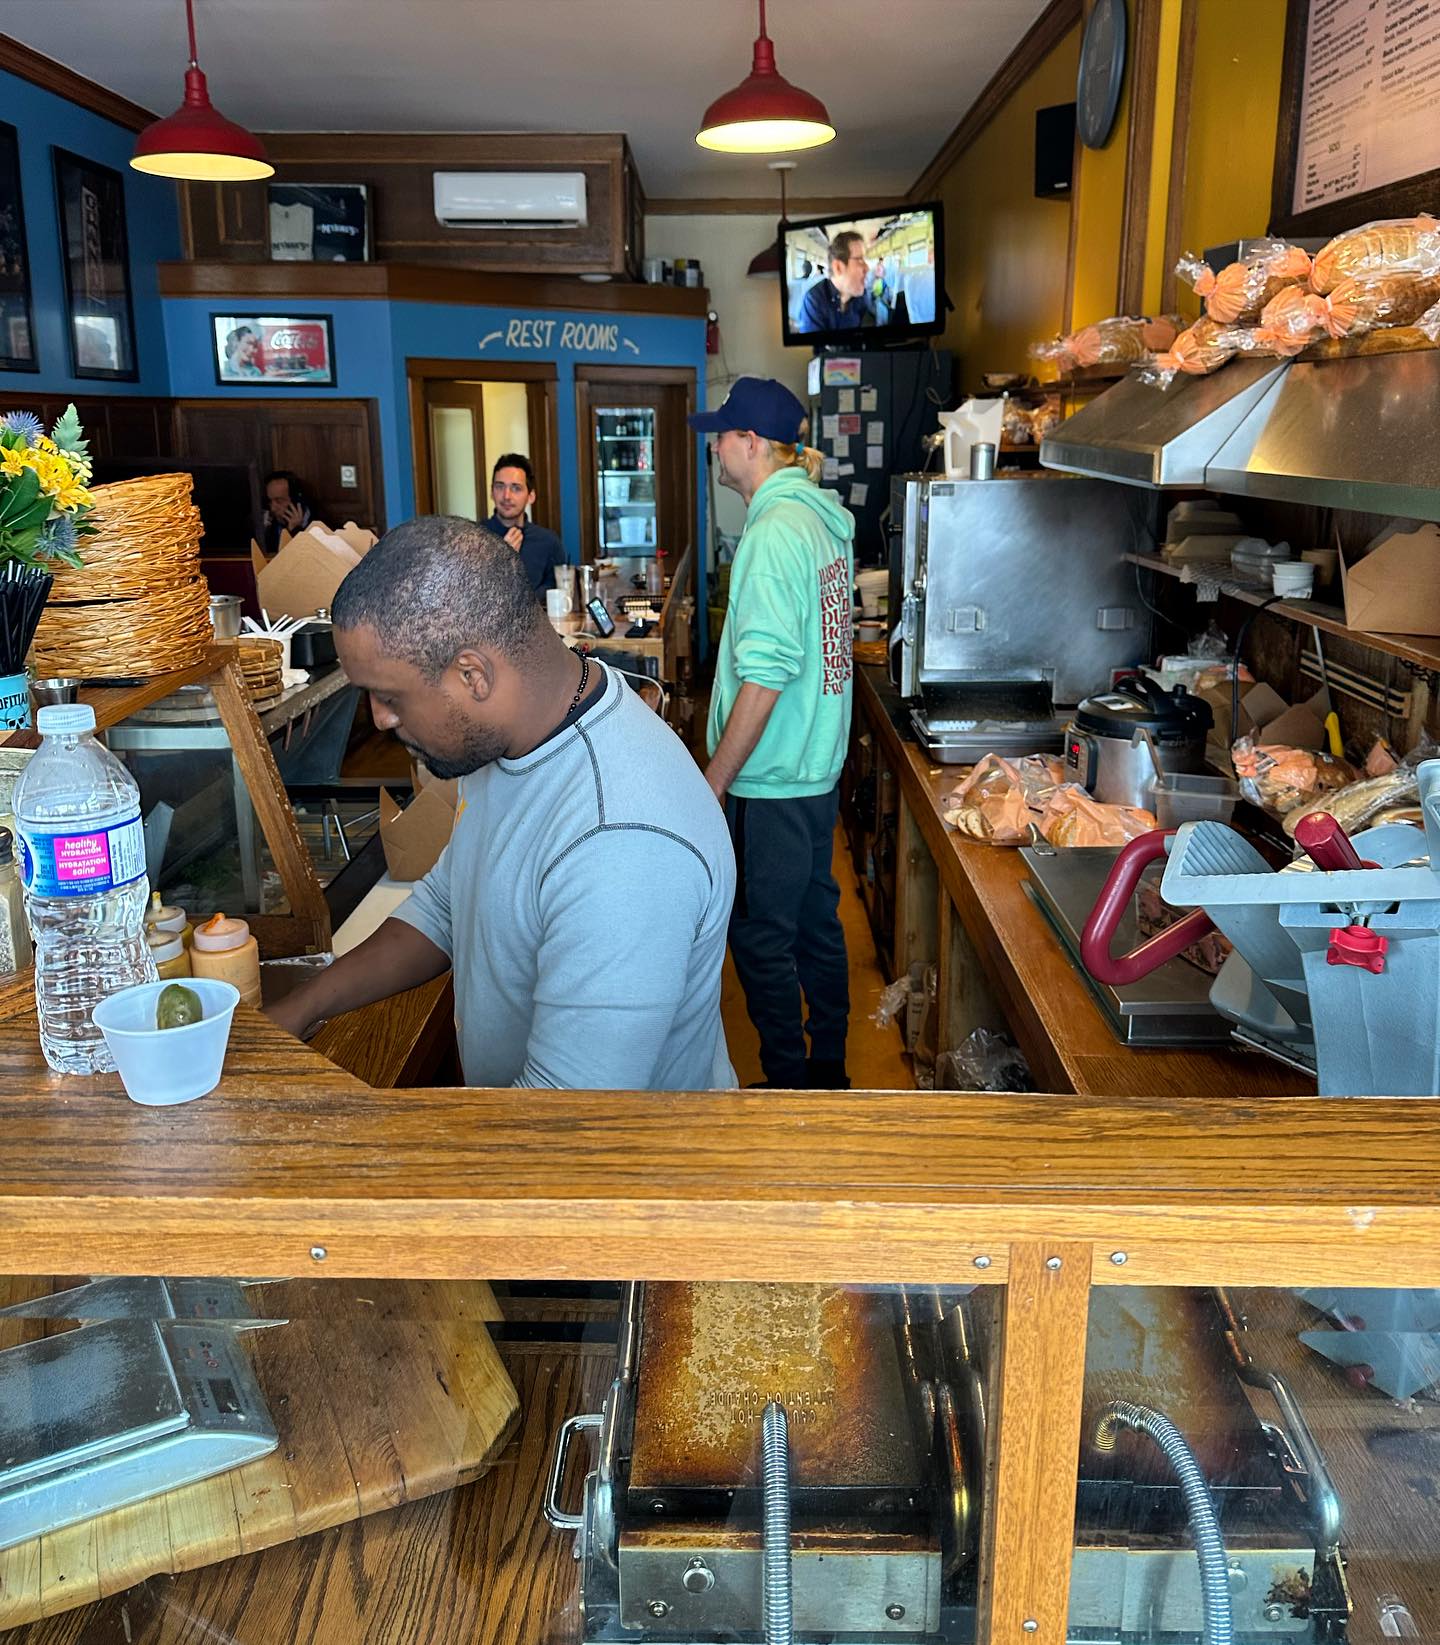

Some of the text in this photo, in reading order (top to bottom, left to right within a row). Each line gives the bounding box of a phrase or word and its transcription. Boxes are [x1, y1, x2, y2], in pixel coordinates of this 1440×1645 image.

[505, 319, 619, 352] REST ROOMS
[64, 838, 97, 850] healthy
[61, 846, 102, 857] HYDRATION
[58, 856, 107, 869] HYDRATATION
[72, 866, 96, 876] saine
